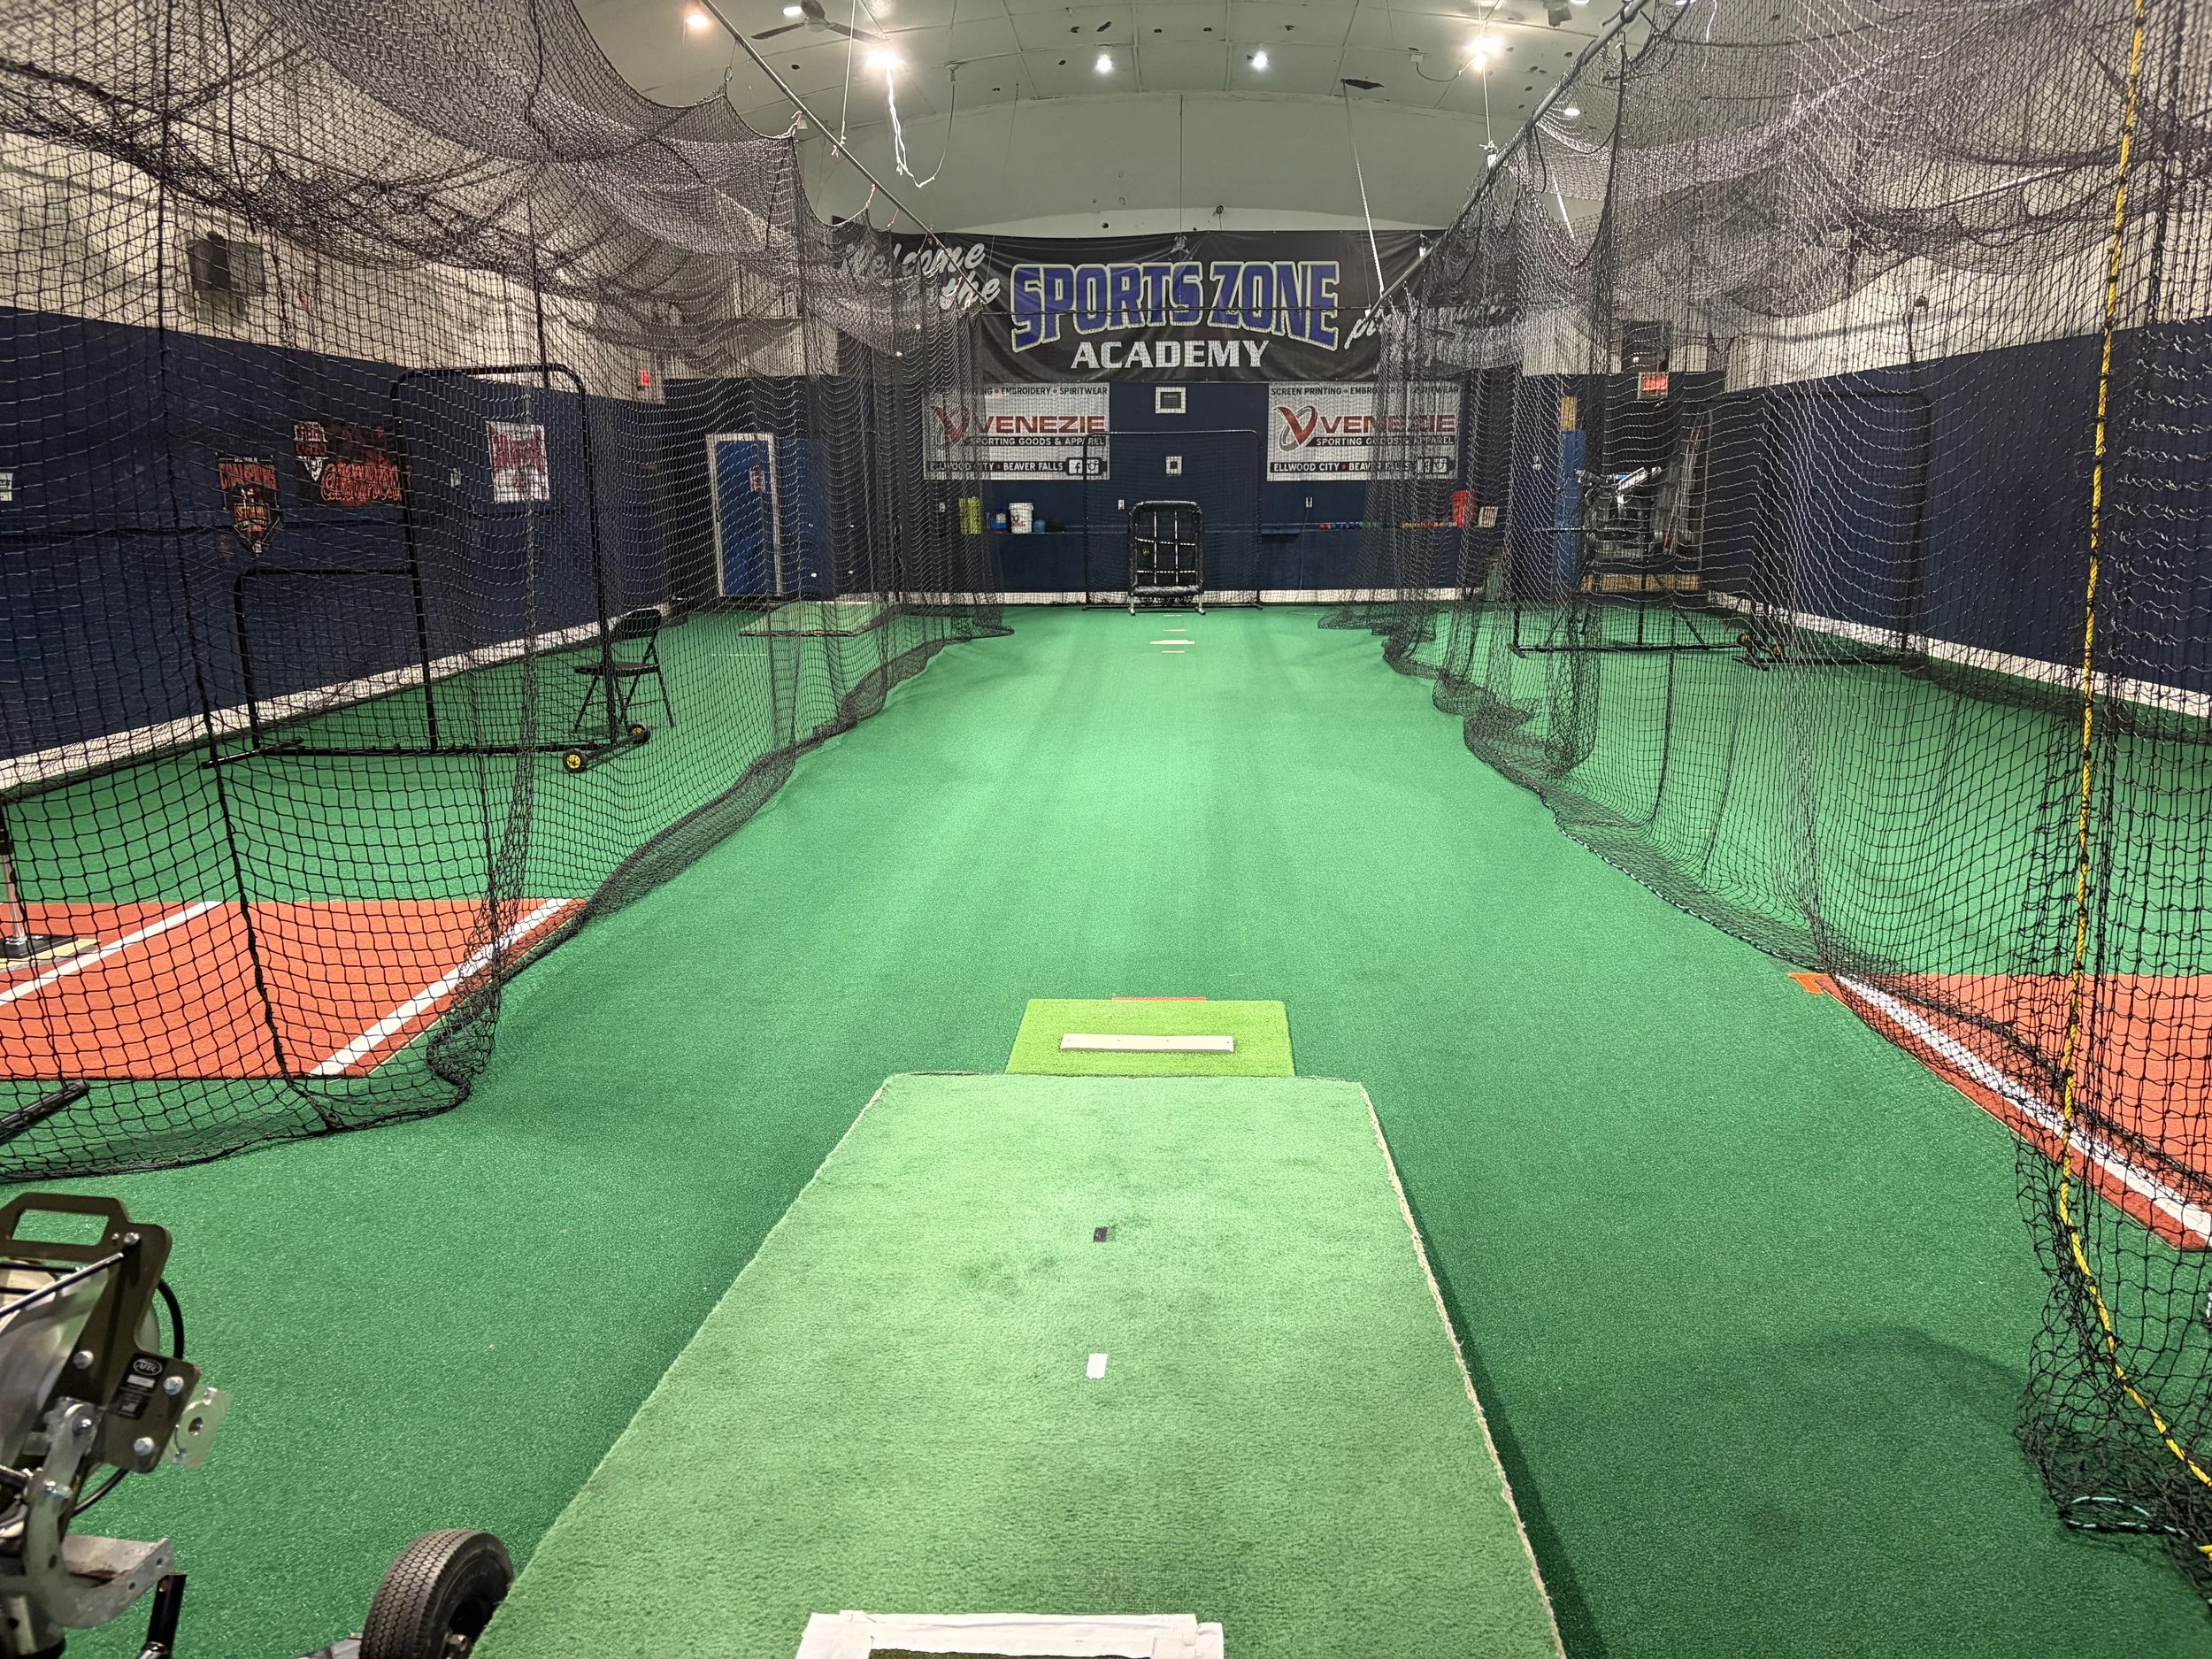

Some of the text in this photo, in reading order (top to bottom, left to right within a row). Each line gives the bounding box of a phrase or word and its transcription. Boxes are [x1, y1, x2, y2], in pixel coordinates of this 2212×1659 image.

[1010, 264, 1203, 353] SPORTS
[1208, 261, 1340, 351] ZONE
[1071, 340, 1270, 369] ACADEMY
[1001, 387, 1051, 396] EMBROIDERY
[1059, 387, 1108, 396] SPIRITWEAR
[1304, 387, 1342, 396] PRINTING
[975, 415, 1106, 434] VENEZIE
[1018, 437, 1051, 446] GOODS
[1054, 437, 1062, 446] &
[1316, 437, 1363, 446] SPORTING
[1414, 435, 1455, 445] PPAREL
[1003, 462, 1036, 471] BEAVER
[1038, 462, 1064, 471] FALLS
[1273, 462, 1409, 472] ELLWOOD CITY BEAVR FLLS
